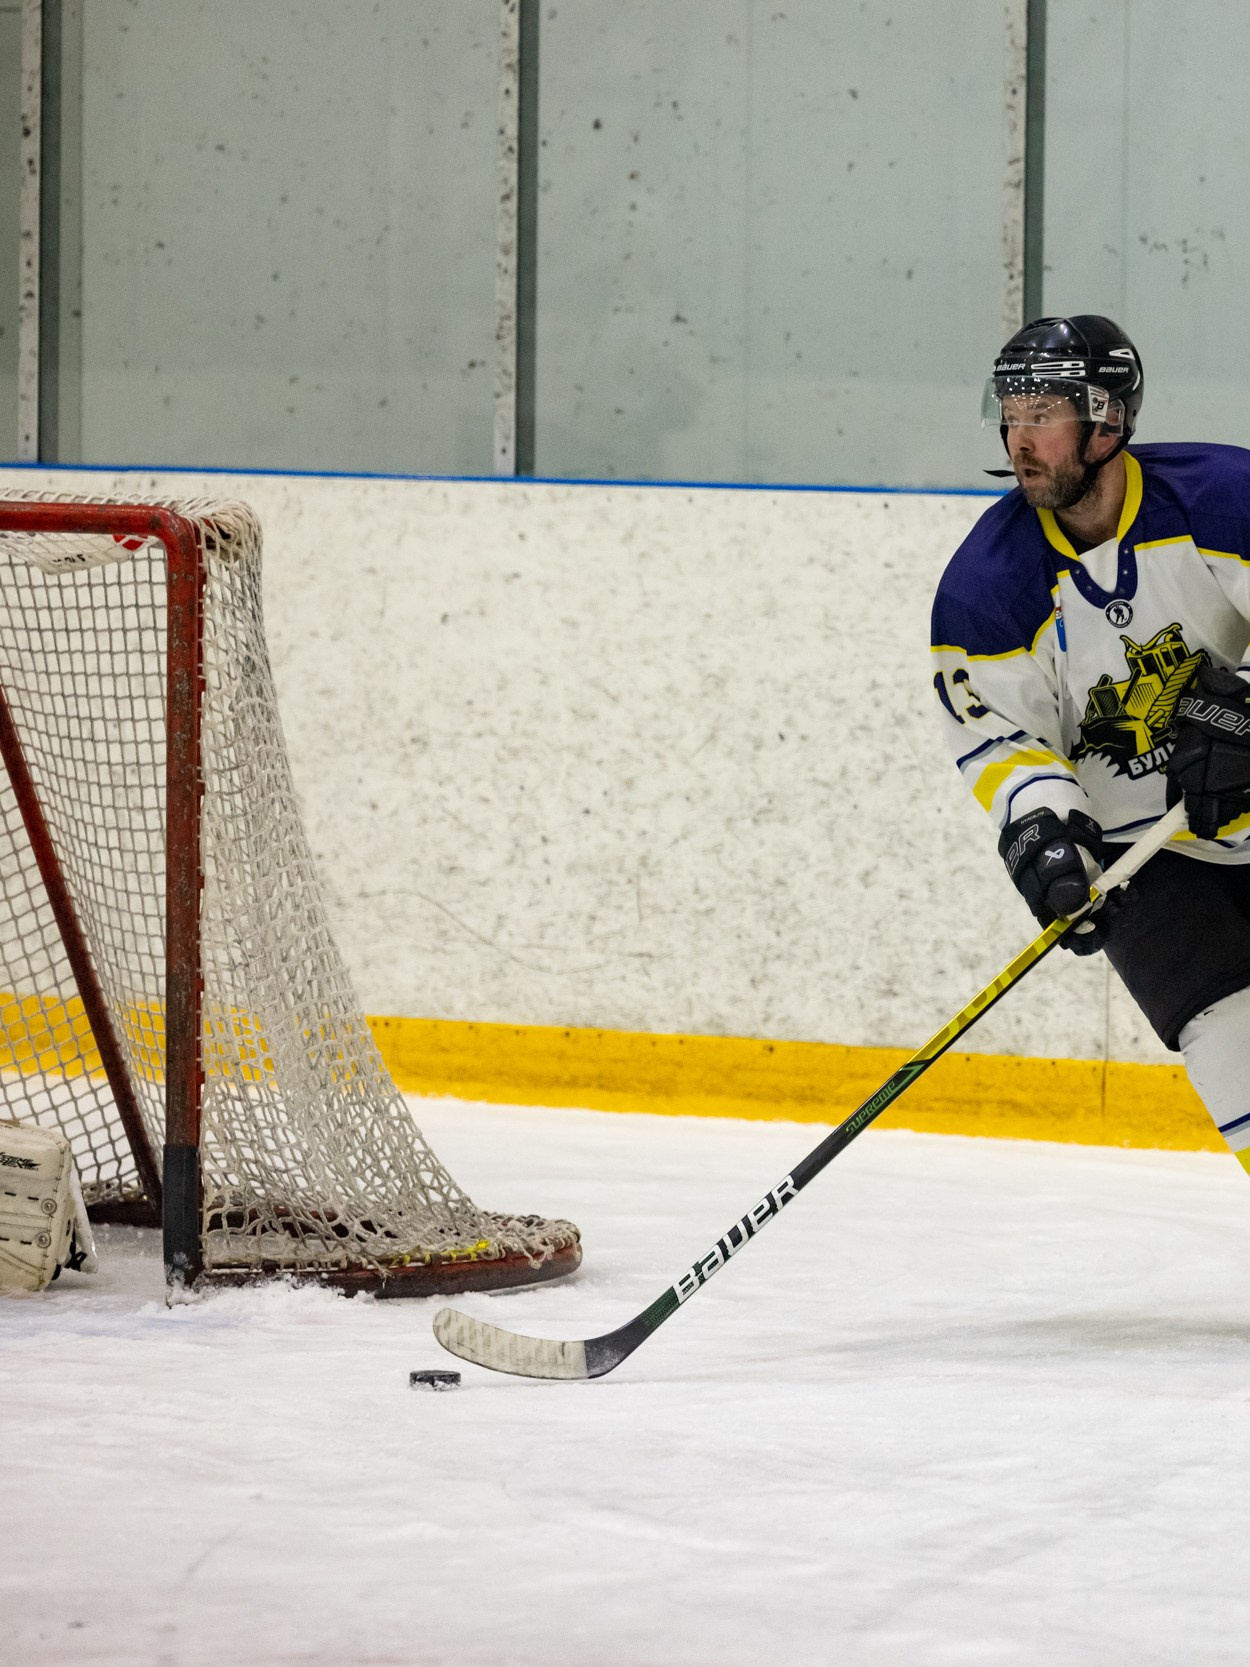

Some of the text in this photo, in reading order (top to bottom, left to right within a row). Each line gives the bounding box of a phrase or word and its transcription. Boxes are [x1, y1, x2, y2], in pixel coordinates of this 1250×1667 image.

[1098, 366, 1129, 374] BAUER
[933, 669, 991, 725] 13
[672, 1173, 800, 1305] BAUER
